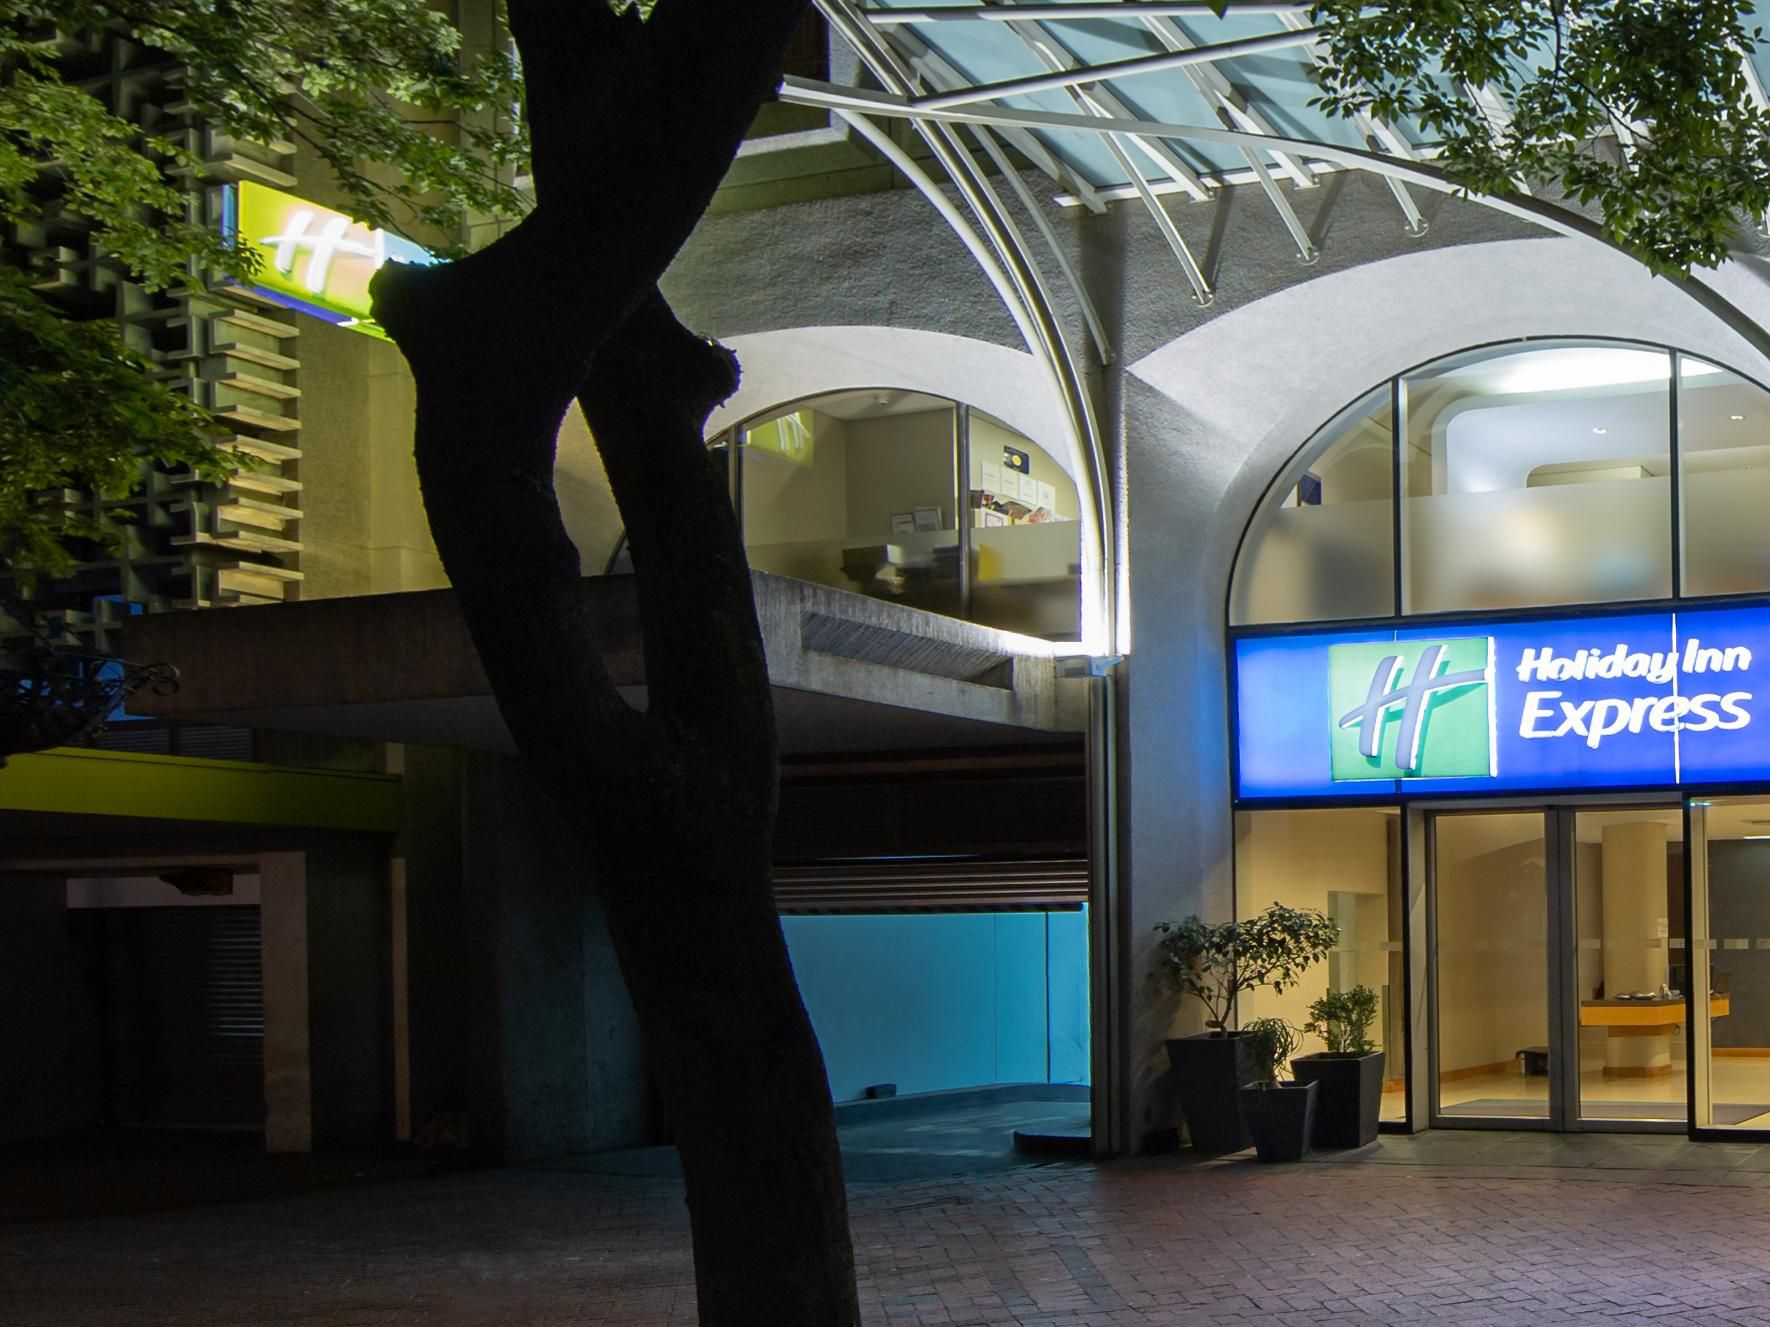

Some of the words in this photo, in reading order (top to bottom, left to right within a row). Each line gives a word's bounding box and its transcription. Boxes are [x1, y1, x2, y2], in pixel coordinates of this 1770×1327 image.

[1515, 643, 1680, 683] Holiday
[1682, 638, 1752, 673] Inn
[1519, 690, 1753, 749] Express
